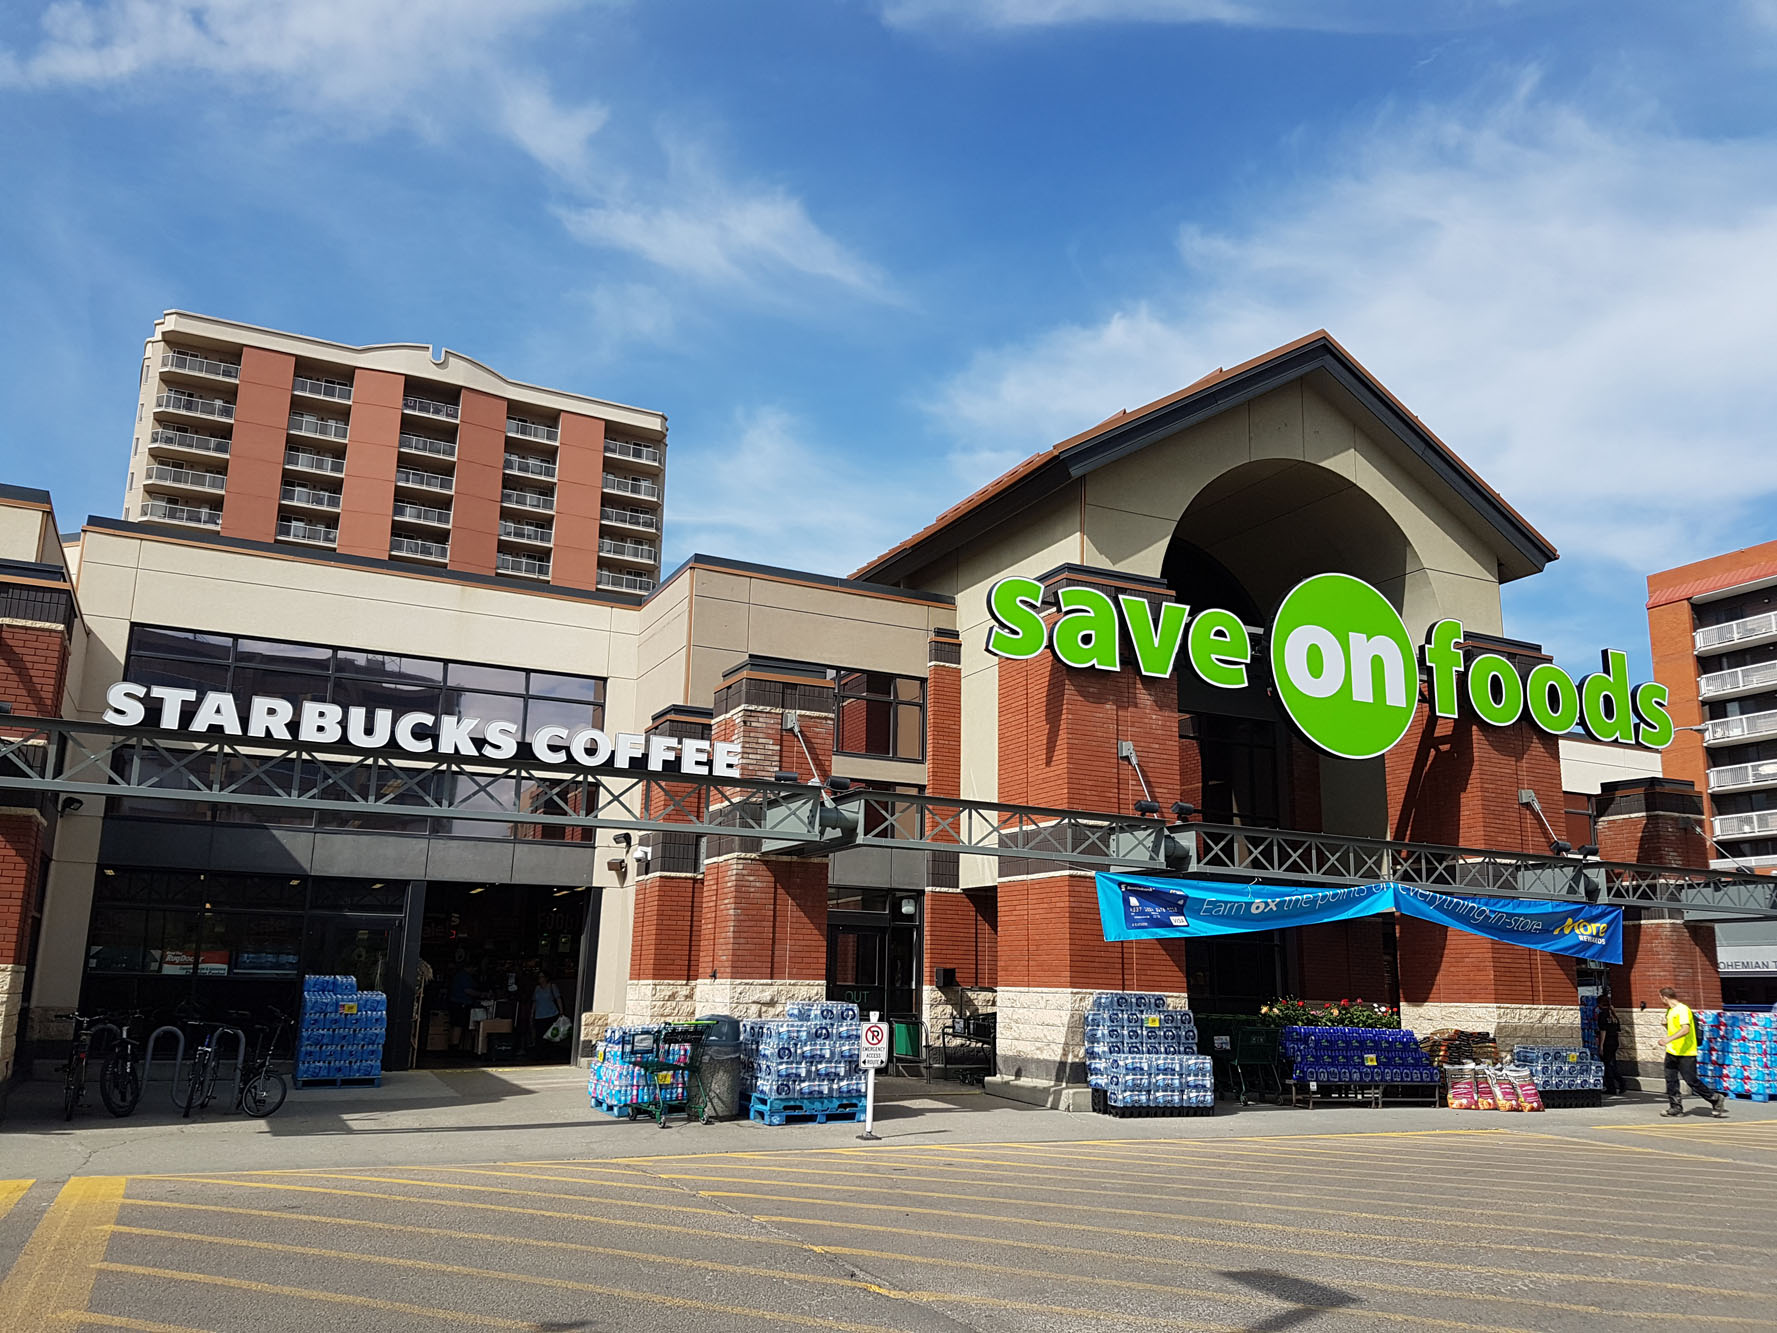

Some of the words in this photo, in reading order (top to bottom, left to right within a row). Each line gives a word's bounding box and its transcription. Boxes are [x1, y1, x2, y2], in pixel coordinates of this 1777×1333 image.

[987, 575, 1251, 689] save
[1284, 624, 1407, 708] on
[1424, 618, 1675, 750] foods
[102, 681, 518, 760] STARBUCKS
[532, 724, 742, 778] COFFEE
[1200, 897, 1246, 916] Earn
[1398, 883, 1490, 924] everything
[1172, 917, 1186, 925] VISA
[1553, 917, 1608, 937] More
[1719, 961, 1769, 969] OHEMIAN
[845, 991, 870, 1003] OUT
